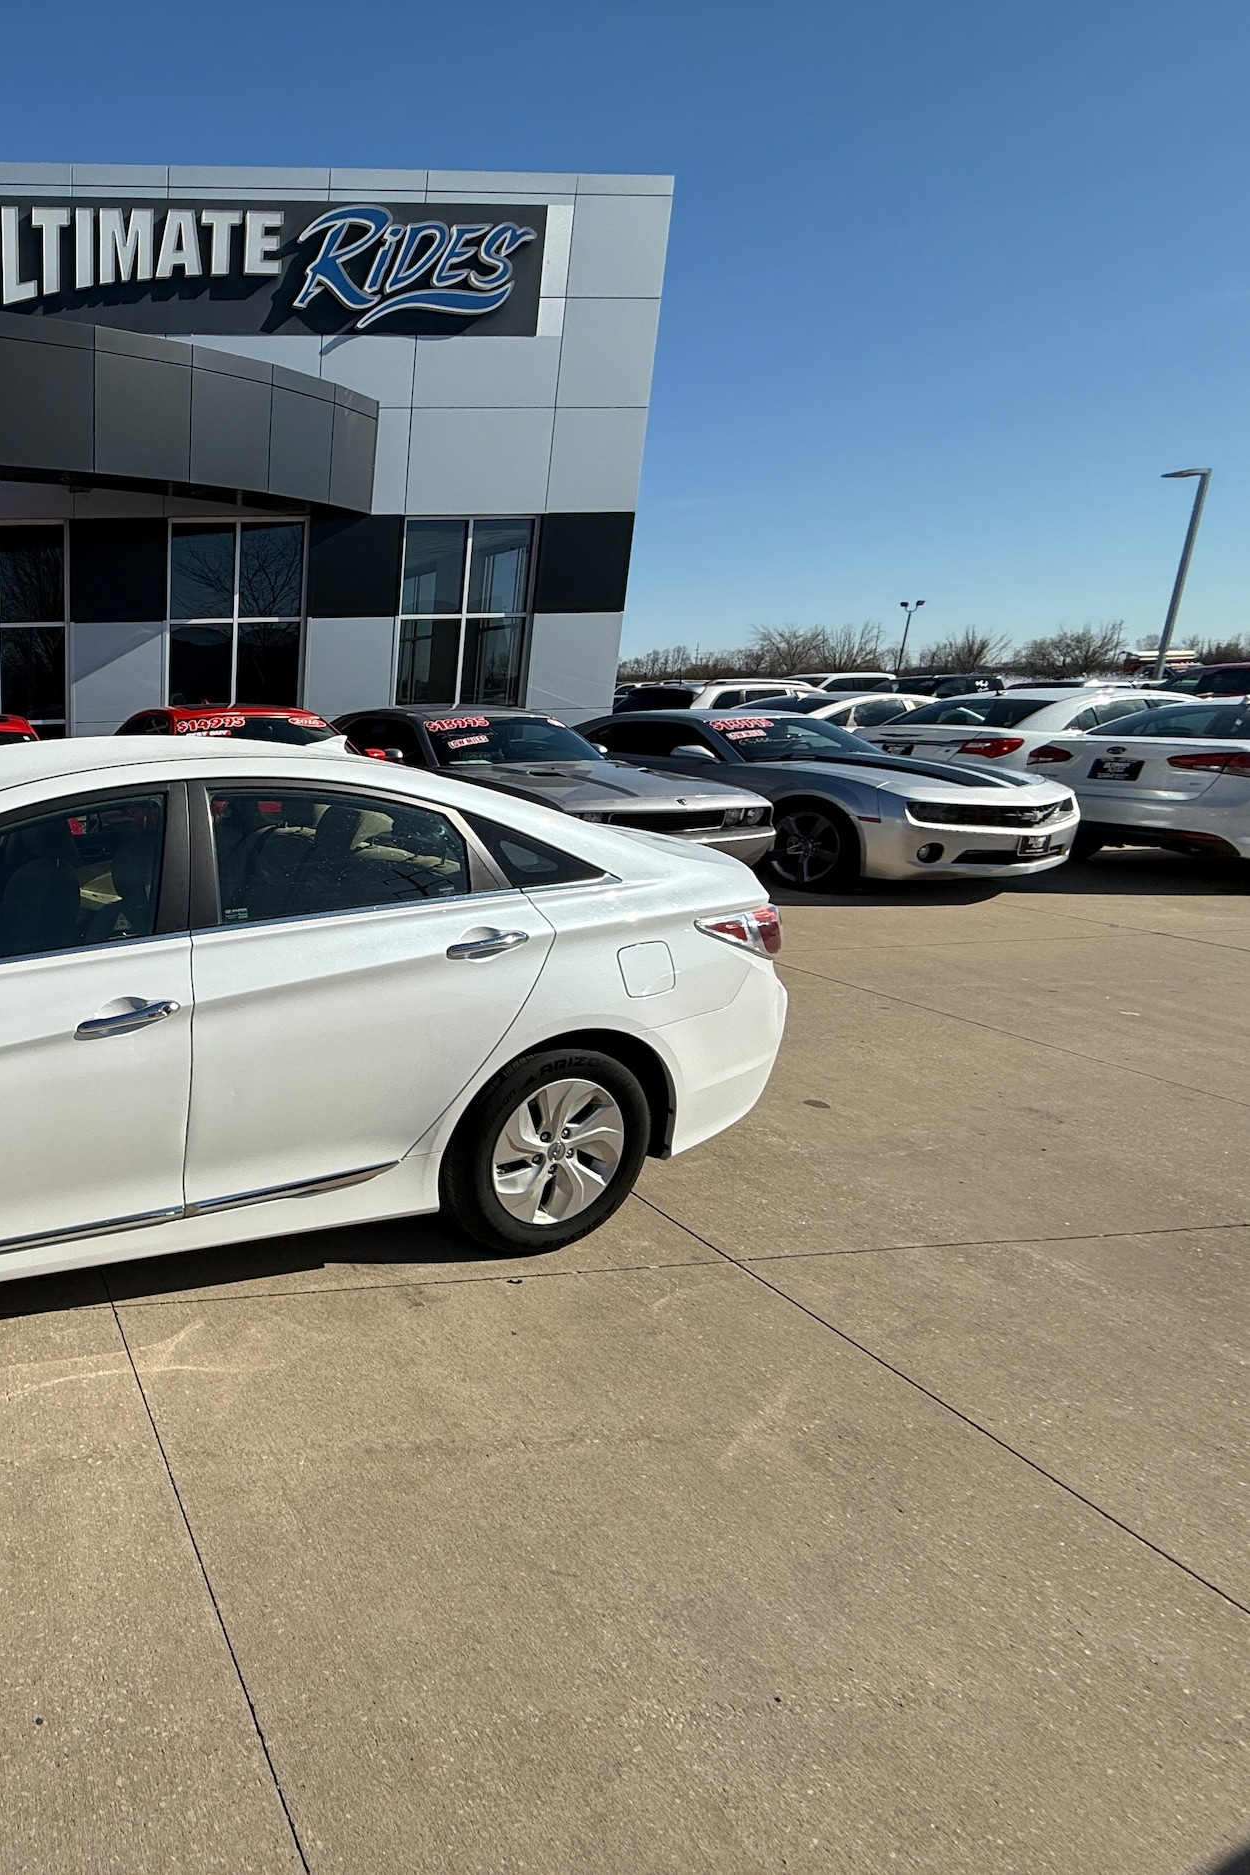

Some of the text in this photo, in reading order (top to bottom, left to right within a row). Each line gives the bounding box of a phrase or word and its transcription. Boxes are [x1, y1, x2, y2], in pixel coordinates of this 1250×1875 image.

[177, 716, 246, 733] $14995
[426, 716, 490, 732] $18995
[449, 741, 465, 749] LOW
